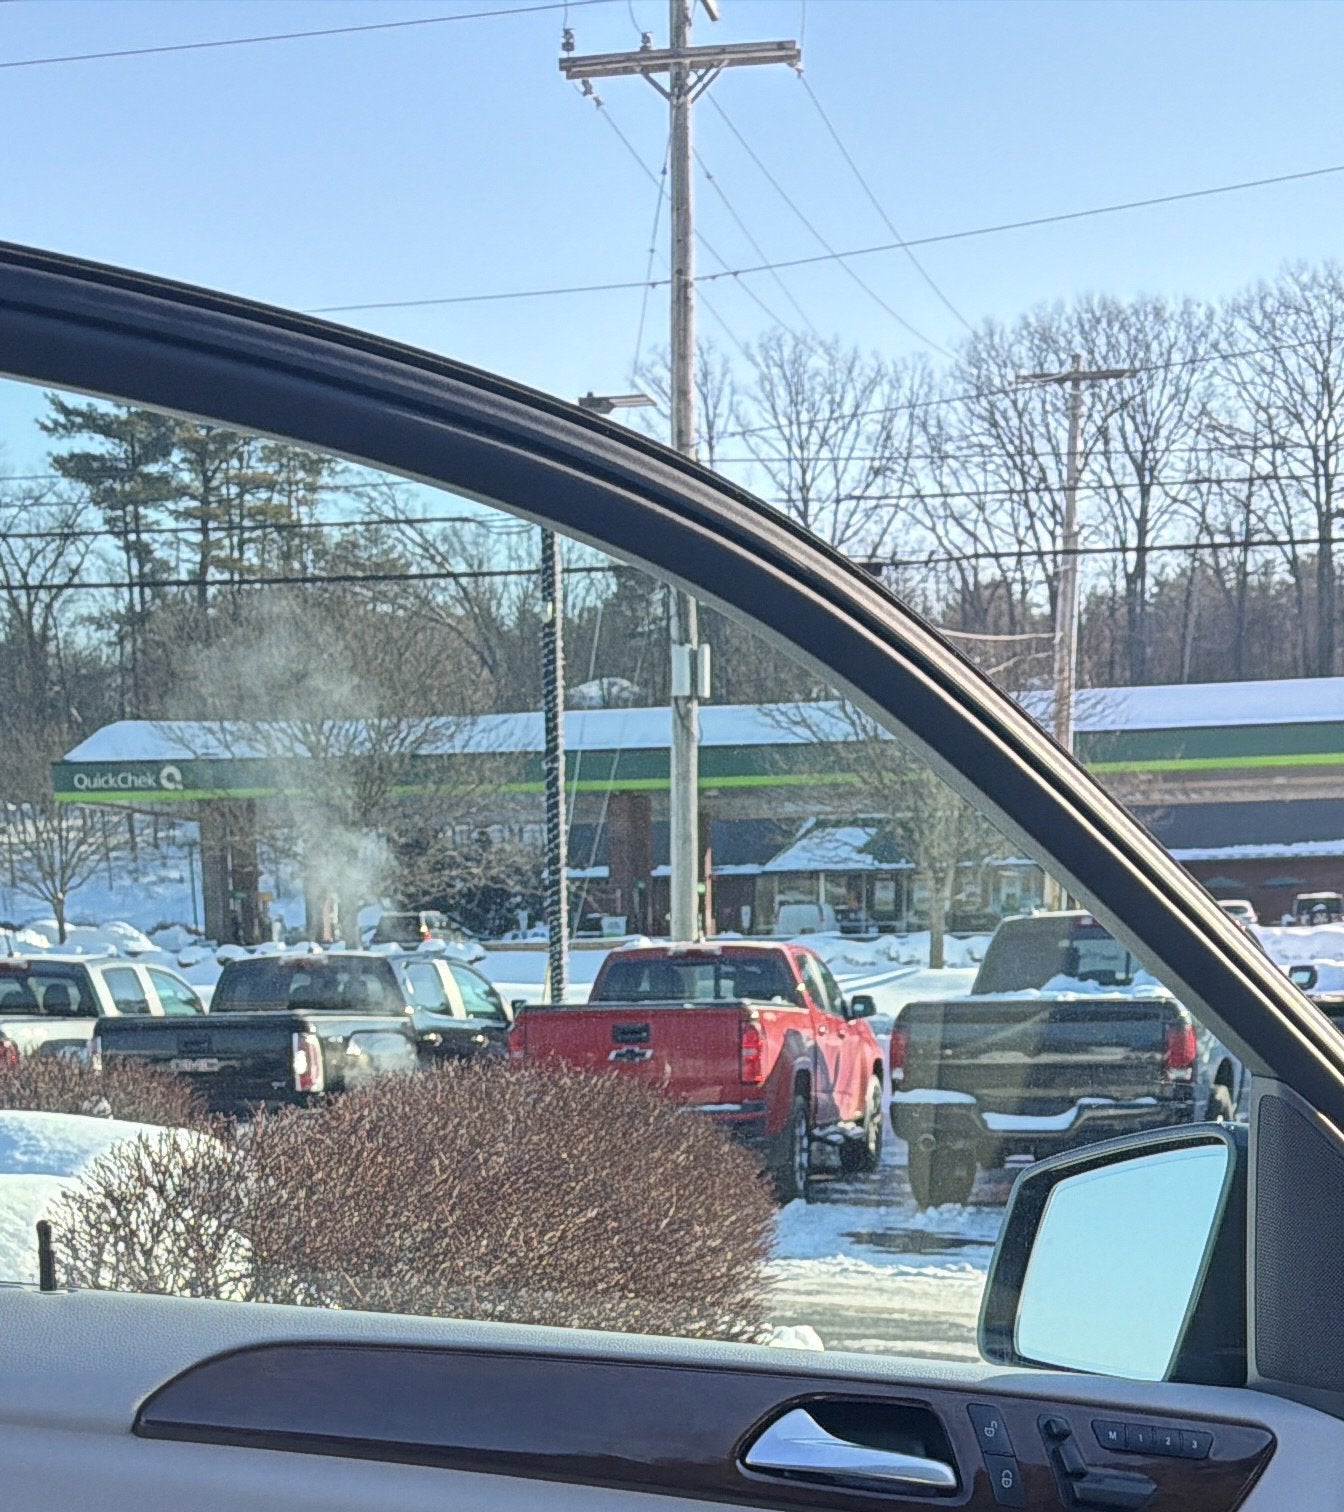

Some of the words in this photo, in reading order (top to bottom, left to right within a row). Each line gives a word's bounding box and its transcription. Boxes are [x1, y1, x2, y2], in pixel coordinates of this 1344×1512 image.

[73, 772, 156, 790] QuickChek
[1108, 1430, 1117, 1441] M
[1138, 1434, 1144, 1443] 1
[1164, 1436, 1172, 1446] 2
[1191, 1440, 1198, 1449] 3
